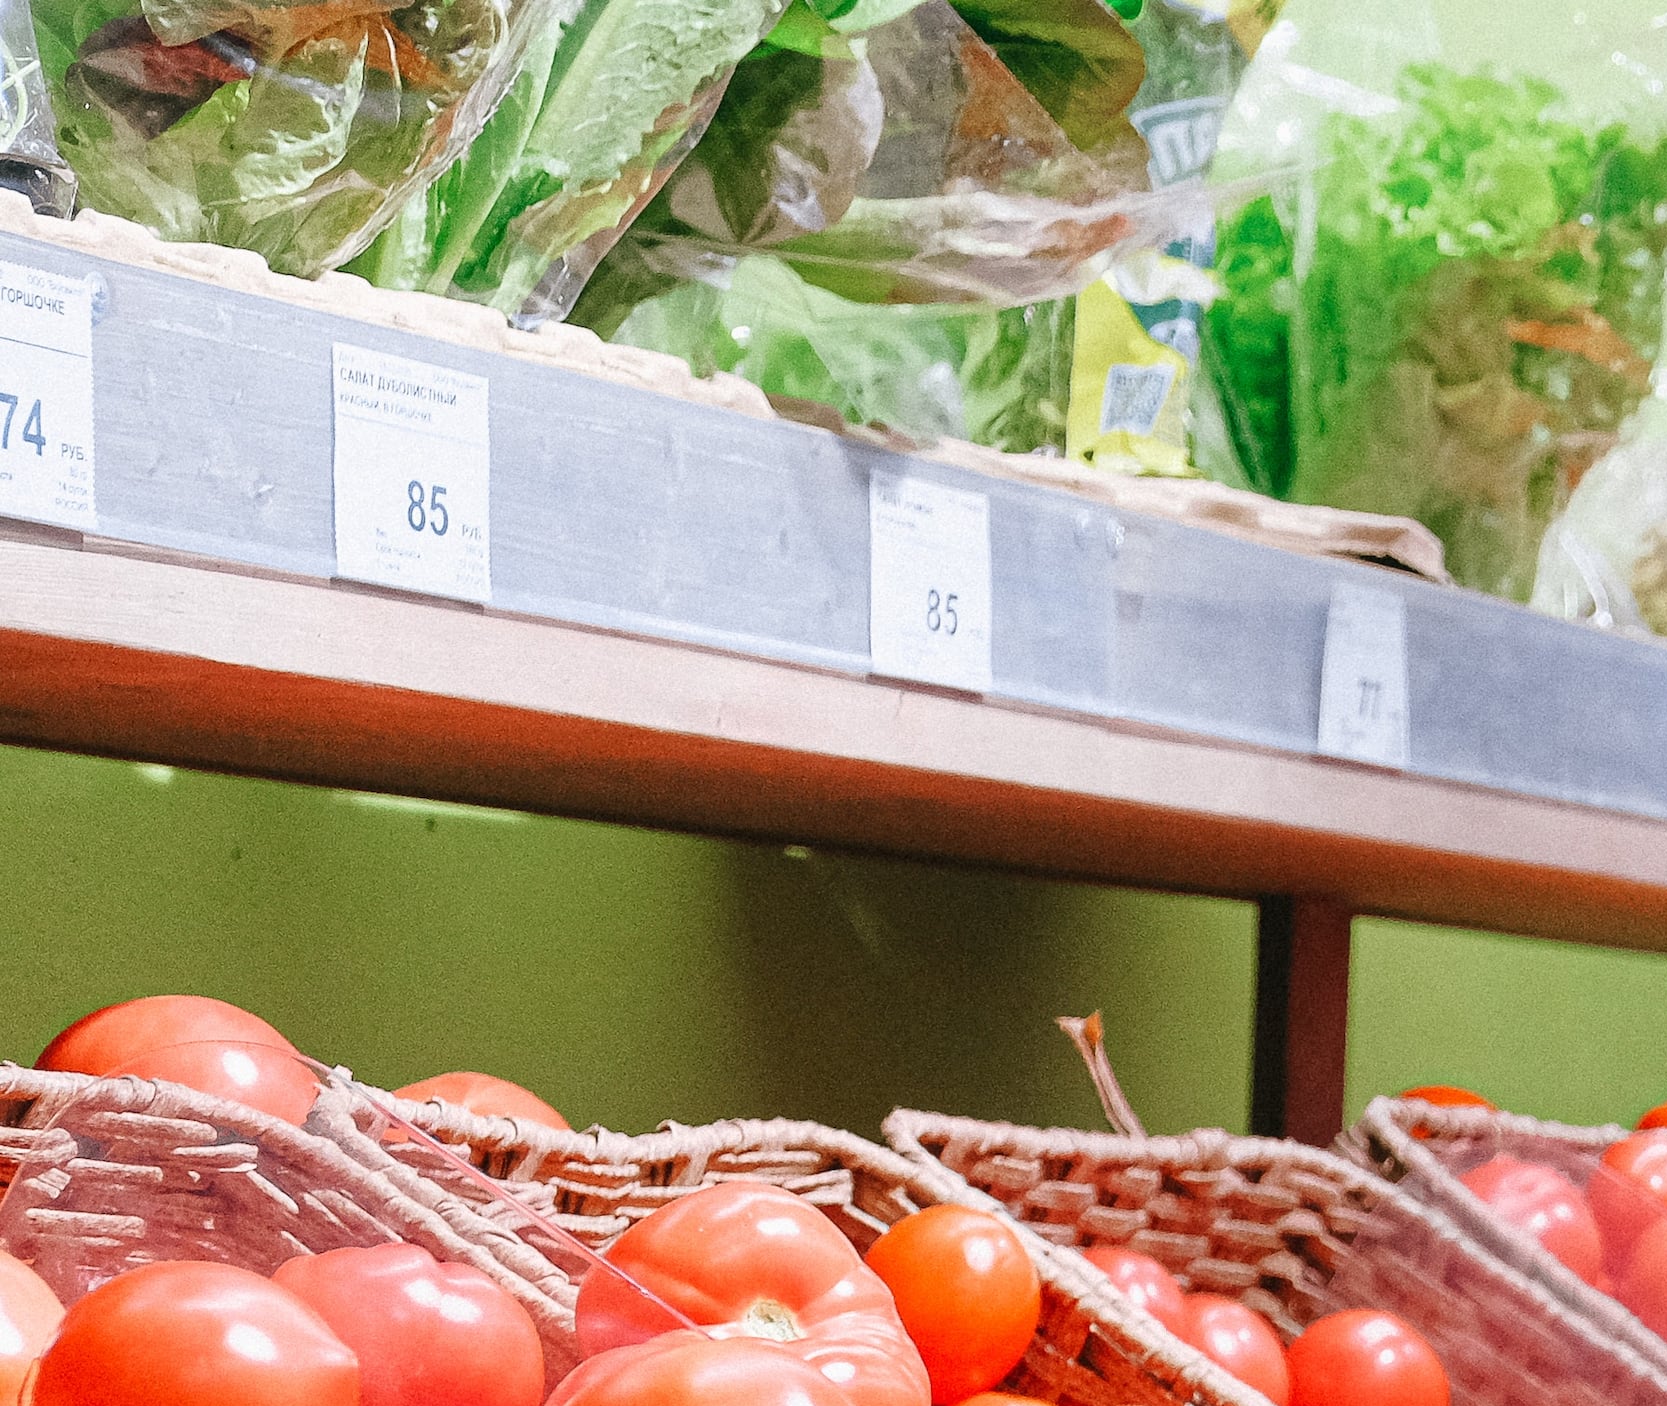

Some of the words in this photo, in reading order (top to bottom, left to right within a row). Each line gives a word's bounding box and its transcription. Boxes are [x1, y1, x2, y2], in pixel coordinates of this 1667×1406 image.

[1, 286, 65, 316] ГОРШОЧКЕ
[340, 367, 374, 387] САЛАТ
[376, 376, 457, 407] ДУБОЛИСТНЫЙ
[61, 443, 88, 461] РУБ.
[407, 480, 449, 536] 85
[927, 589, 958, 636] 85
